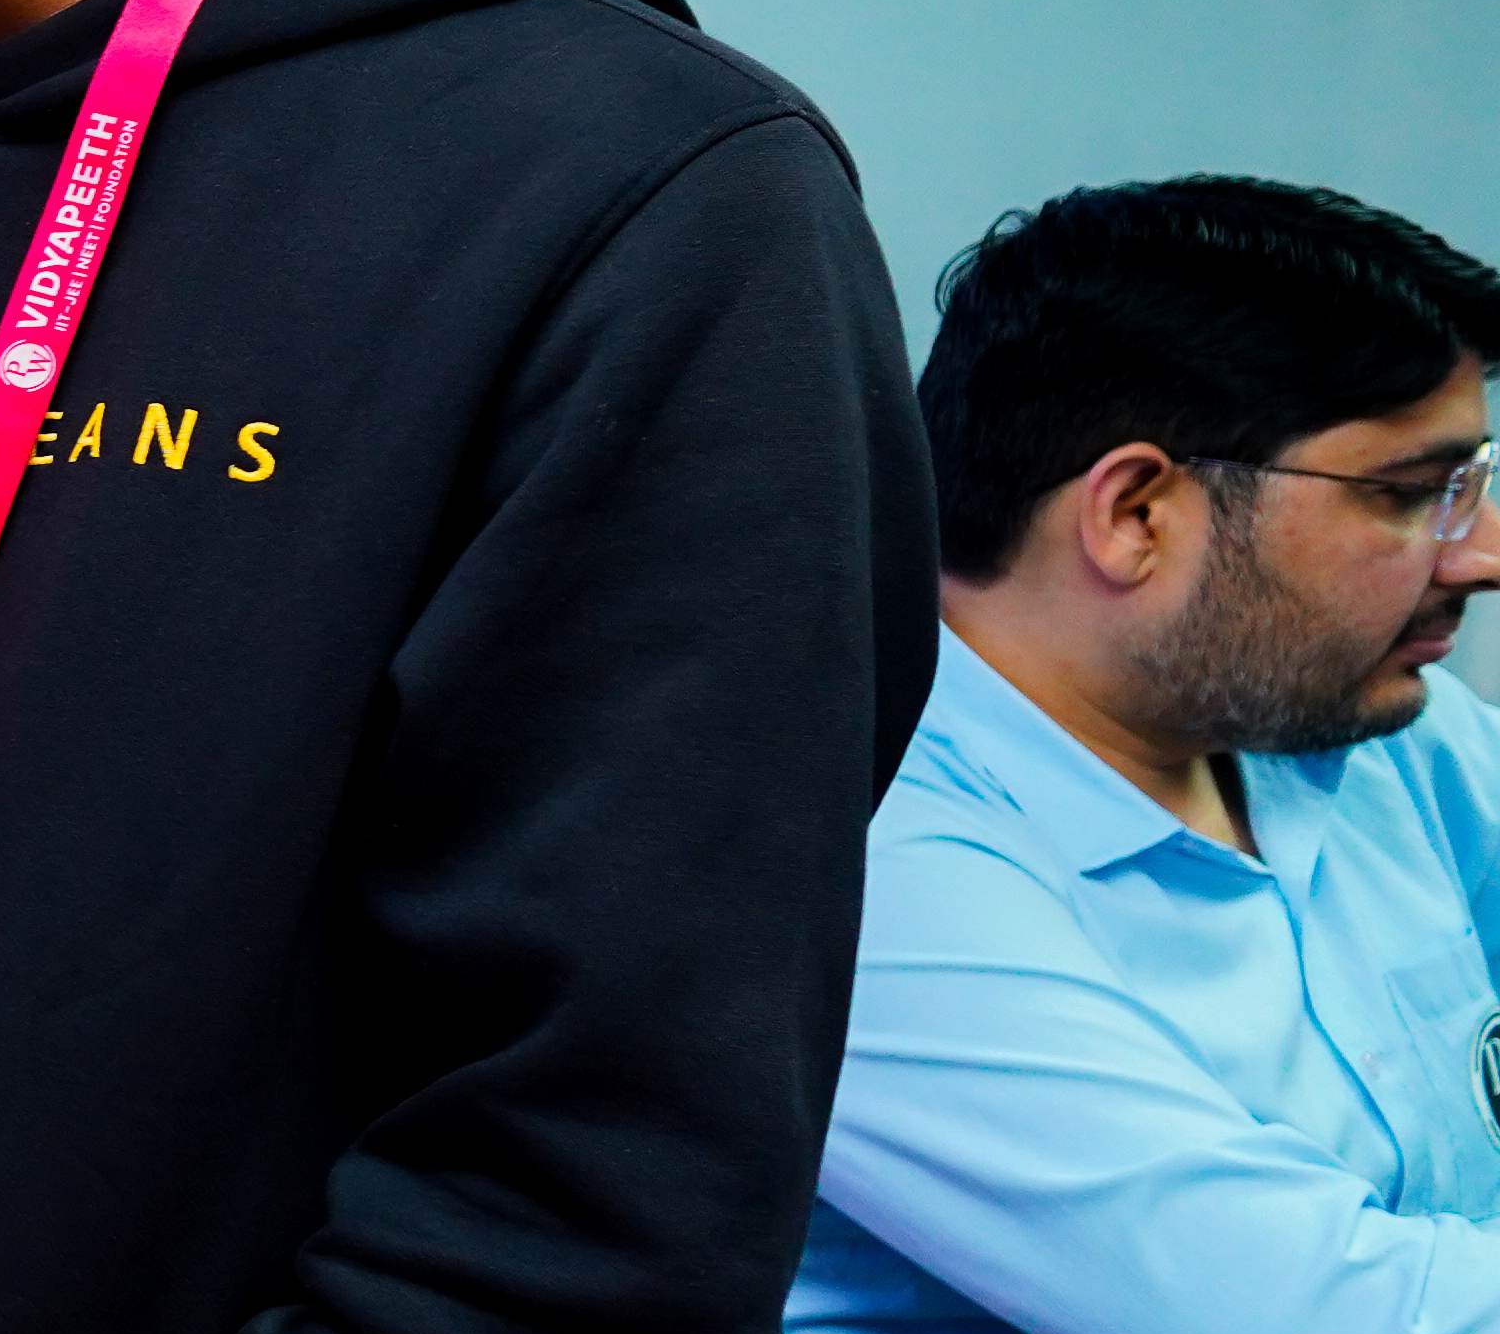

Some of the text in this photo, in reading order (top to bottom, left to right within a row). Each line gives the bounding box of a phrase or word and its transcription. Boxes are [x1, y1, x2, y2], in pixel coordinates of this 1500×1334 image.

[16, 112, 118, 329] VIDYAPEETH
[53, 119, 139, 332] IIT-JEE NEET FOUNDATION
[26, 402, 281, 483] EANS
